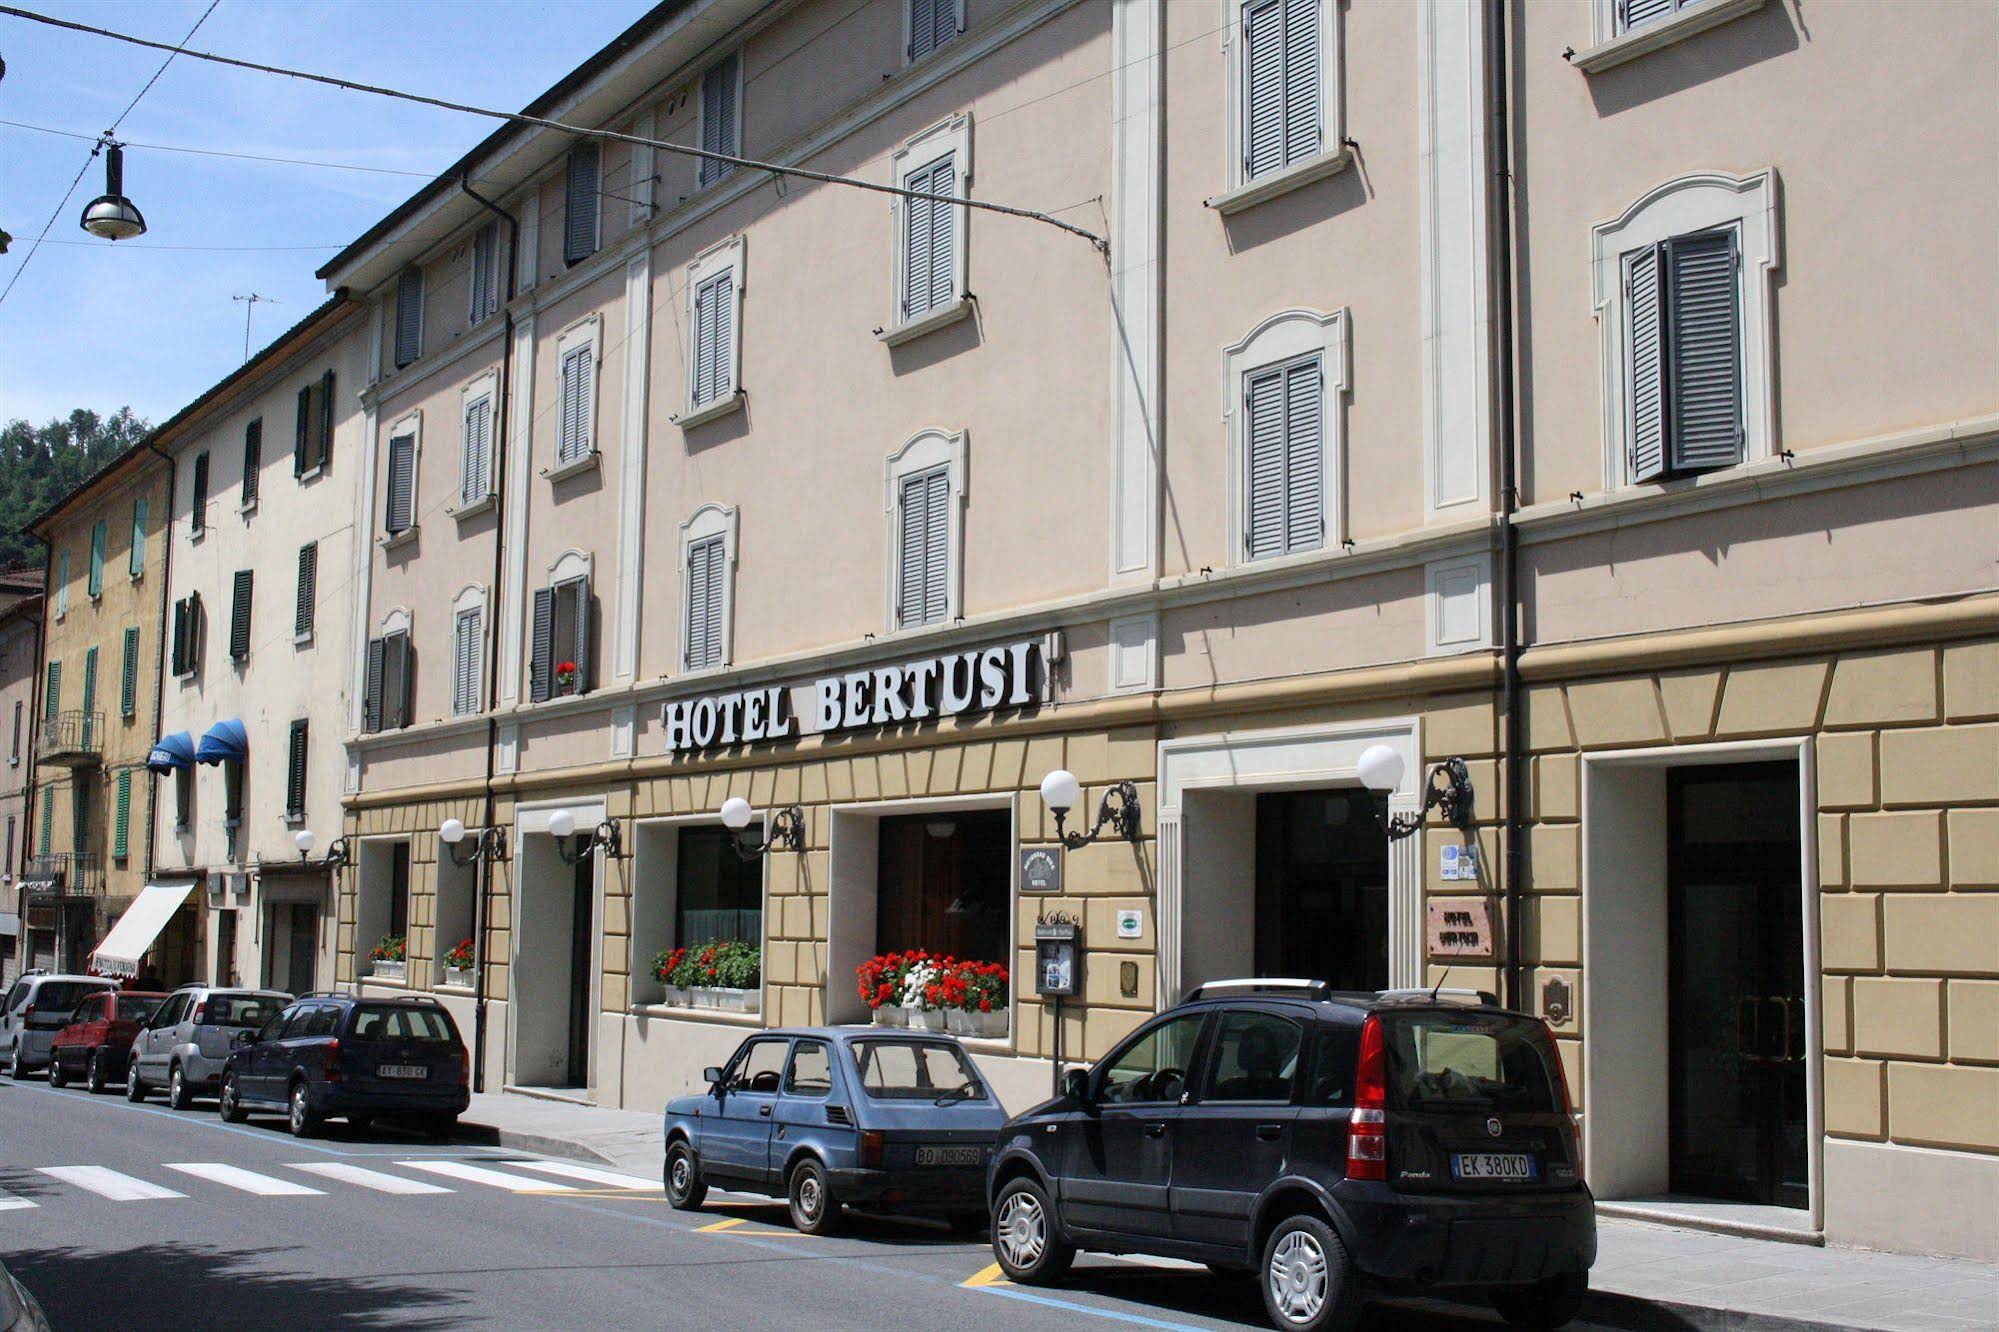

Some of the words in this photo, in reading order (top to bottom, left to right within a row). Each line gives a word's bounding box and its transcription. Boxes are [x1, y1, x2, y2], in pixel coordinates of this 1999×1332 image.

[665, 686, 792, 751] HOTEL
[814, 642, 1040, 731] BERTUSI
[1400, 1170, 1431, 1179] Panda
[1461, 1156, 1481, 1176] EK
[1486, 1156, 1528, 1176] 380KD
